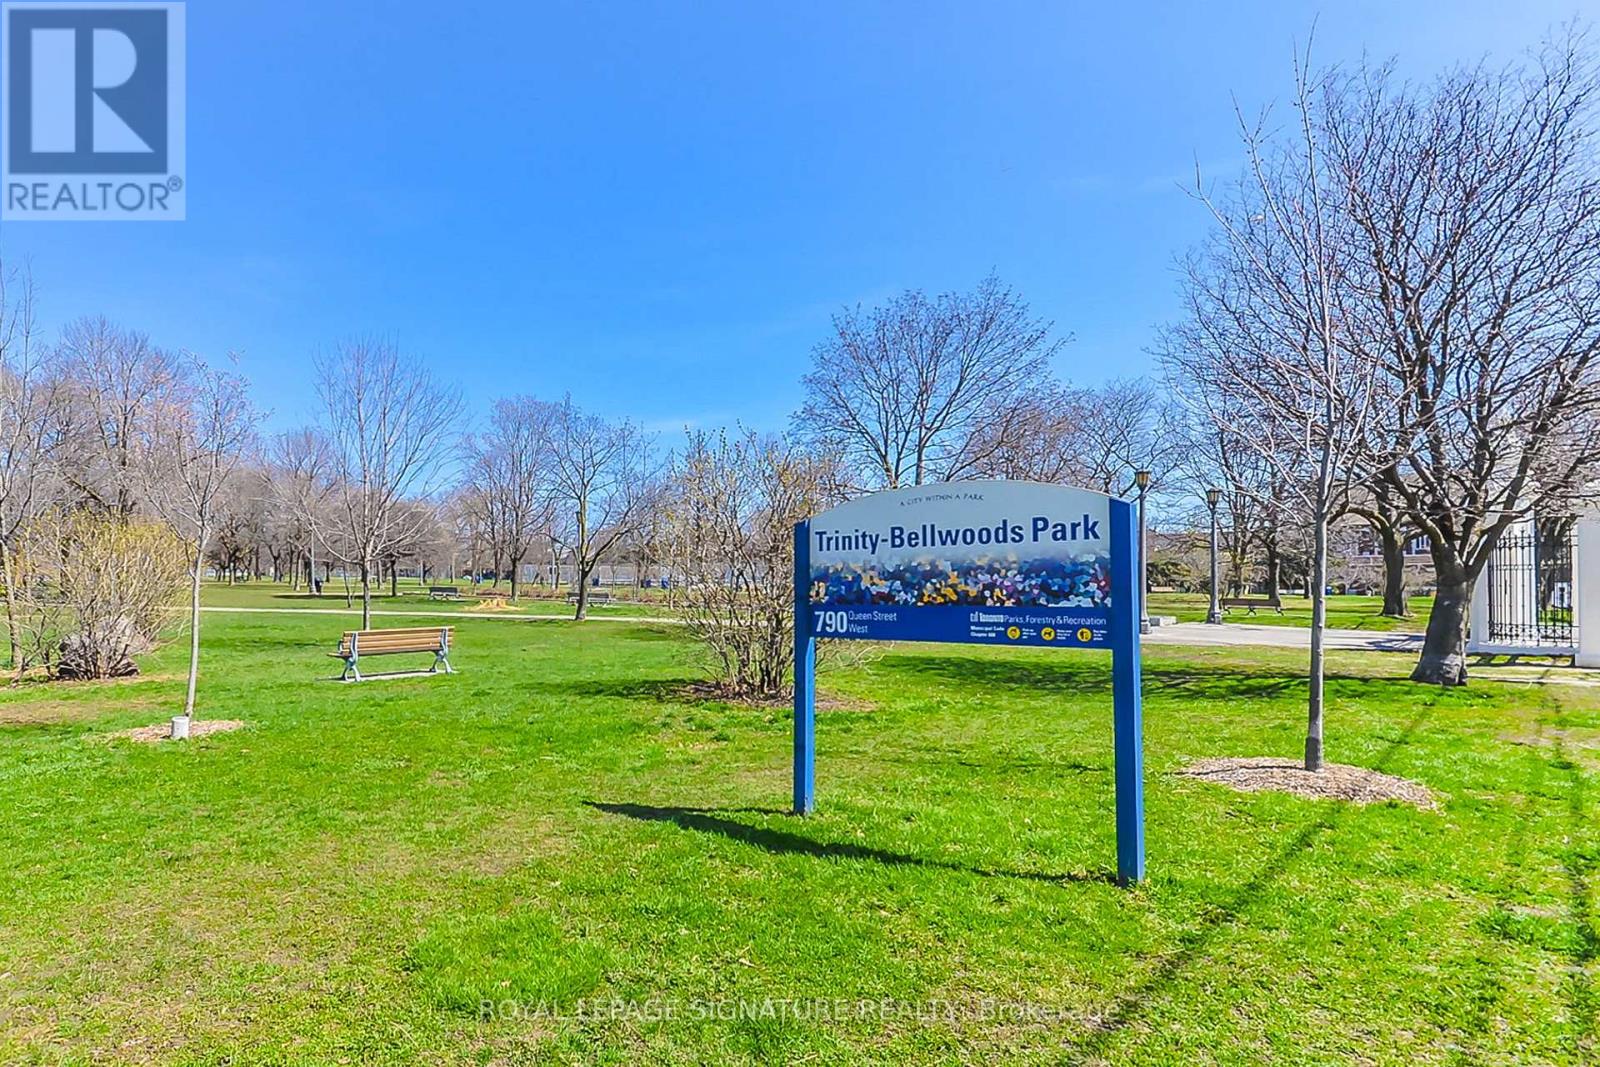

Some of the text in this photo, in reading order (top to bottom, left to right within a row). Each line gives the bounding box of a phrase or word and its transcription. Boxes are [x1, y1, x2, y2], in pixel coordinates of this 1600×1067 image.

[907, 497, 922, 505] CITY
[926, 494, 952, 502] WITHIN
[964, 493, 984, 501] PARK
[814, 513, 1101, 555] Trinity-Bellwoods Park
[848, 610, 897, 621] Queen Street
[814, 611, 848, 633] 790
[848, 623, 868, 633] West
